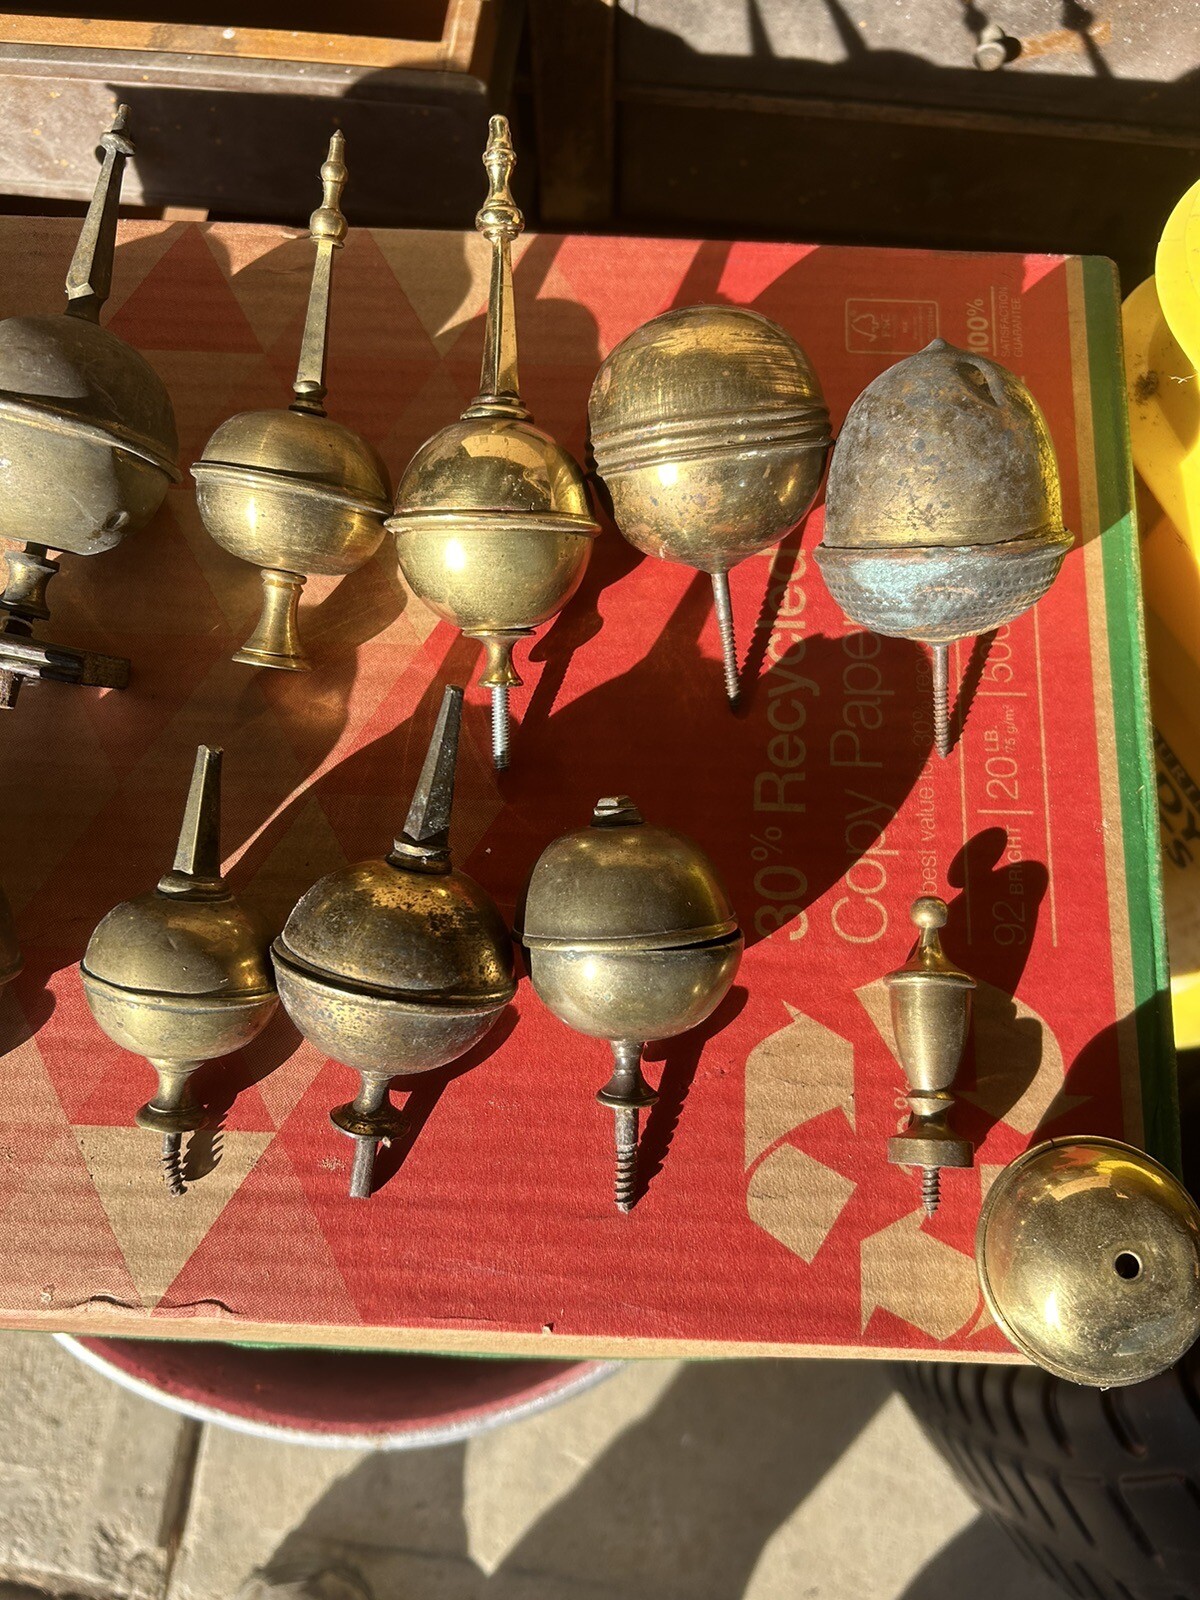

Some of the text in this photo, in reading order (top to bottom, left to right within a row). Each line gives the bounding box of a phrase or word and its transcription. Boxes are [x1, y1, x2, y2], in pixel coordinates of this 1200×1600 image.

[965, 298, 989, 353] 100%
[998, 286, 1010, 358] SATISFACTION
[1011, 297, 1023, 358] GUARANTEE
[749, 549, 820, 941] 30% Recycled
[914, 755, 935, 780] for
[984, 724, 1020, 800] 20 LB.
[1003, 738, 1016, 753] 75
[916, 788, 937, 841] value
[831, 788, 898, 945] Copy
[918, 849, 938, 896] best
[992, 824, 1027, 947] 92 BRIGHT
